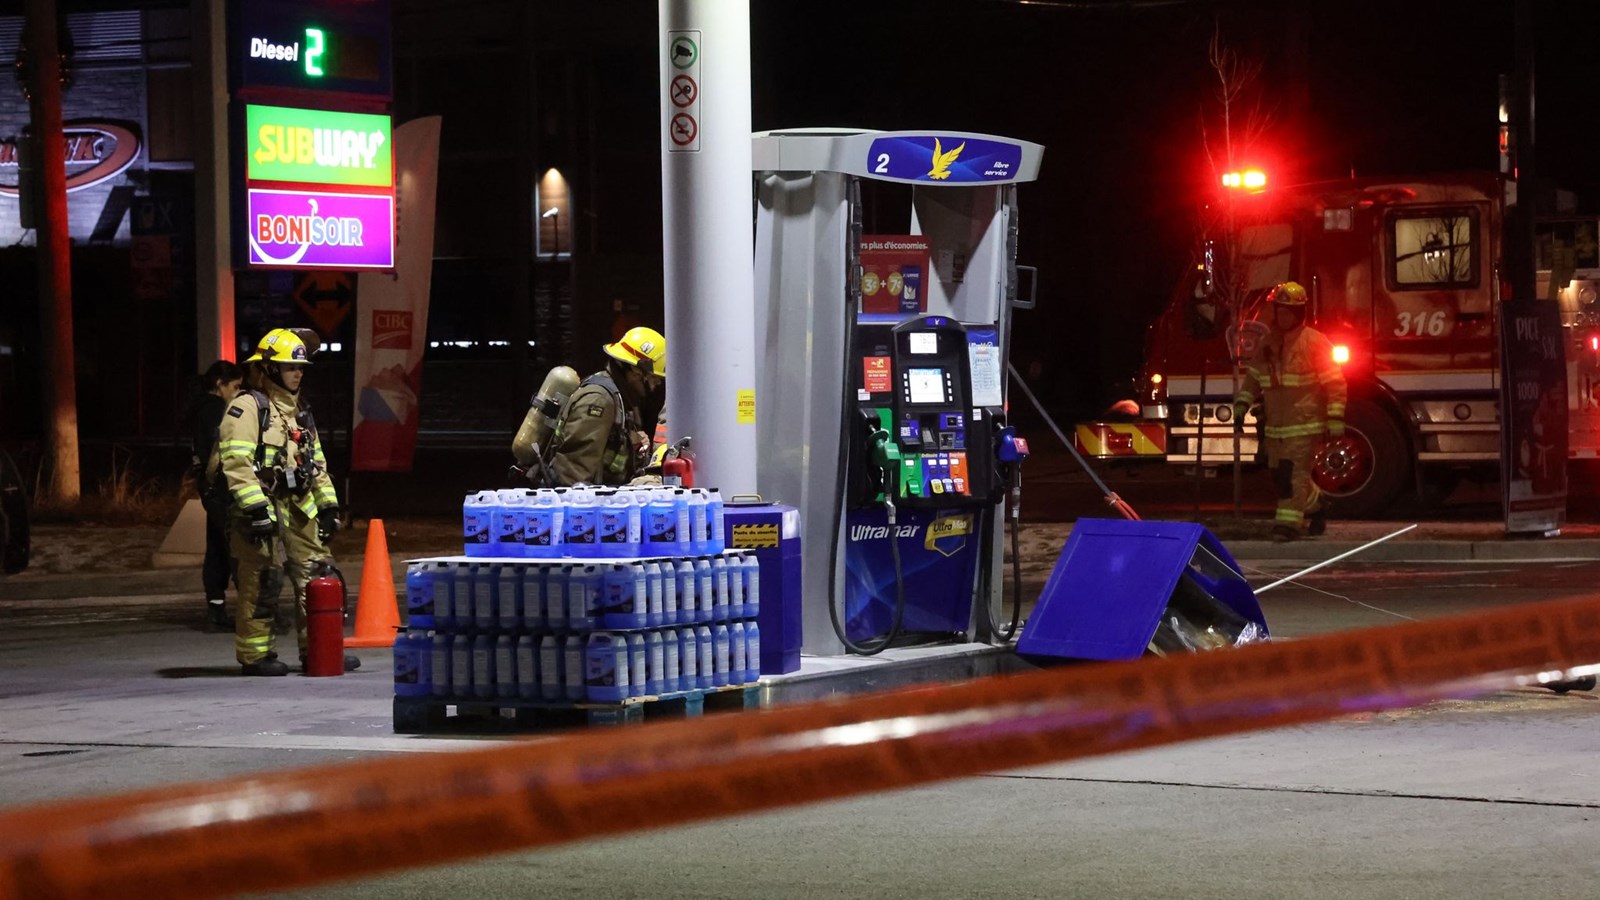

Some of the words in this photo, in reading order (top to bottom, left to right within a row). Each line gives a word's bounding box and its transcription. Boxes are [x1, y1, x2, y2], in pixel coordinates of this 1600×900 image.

[250, 37, 299, 62] Diesel
[305, 28, 324, 76] 2
[254, 124, 386, 168] SUBWAY
[874, 153, 890, 173] 2
[993, 161, 1009, 169] libre
[869, 241, 883, 250] plus
[375, 313, 409, 329] CIBC
[1393, 311, 1446, 336] 316
[851, 524, 920, 541] Ultramar
